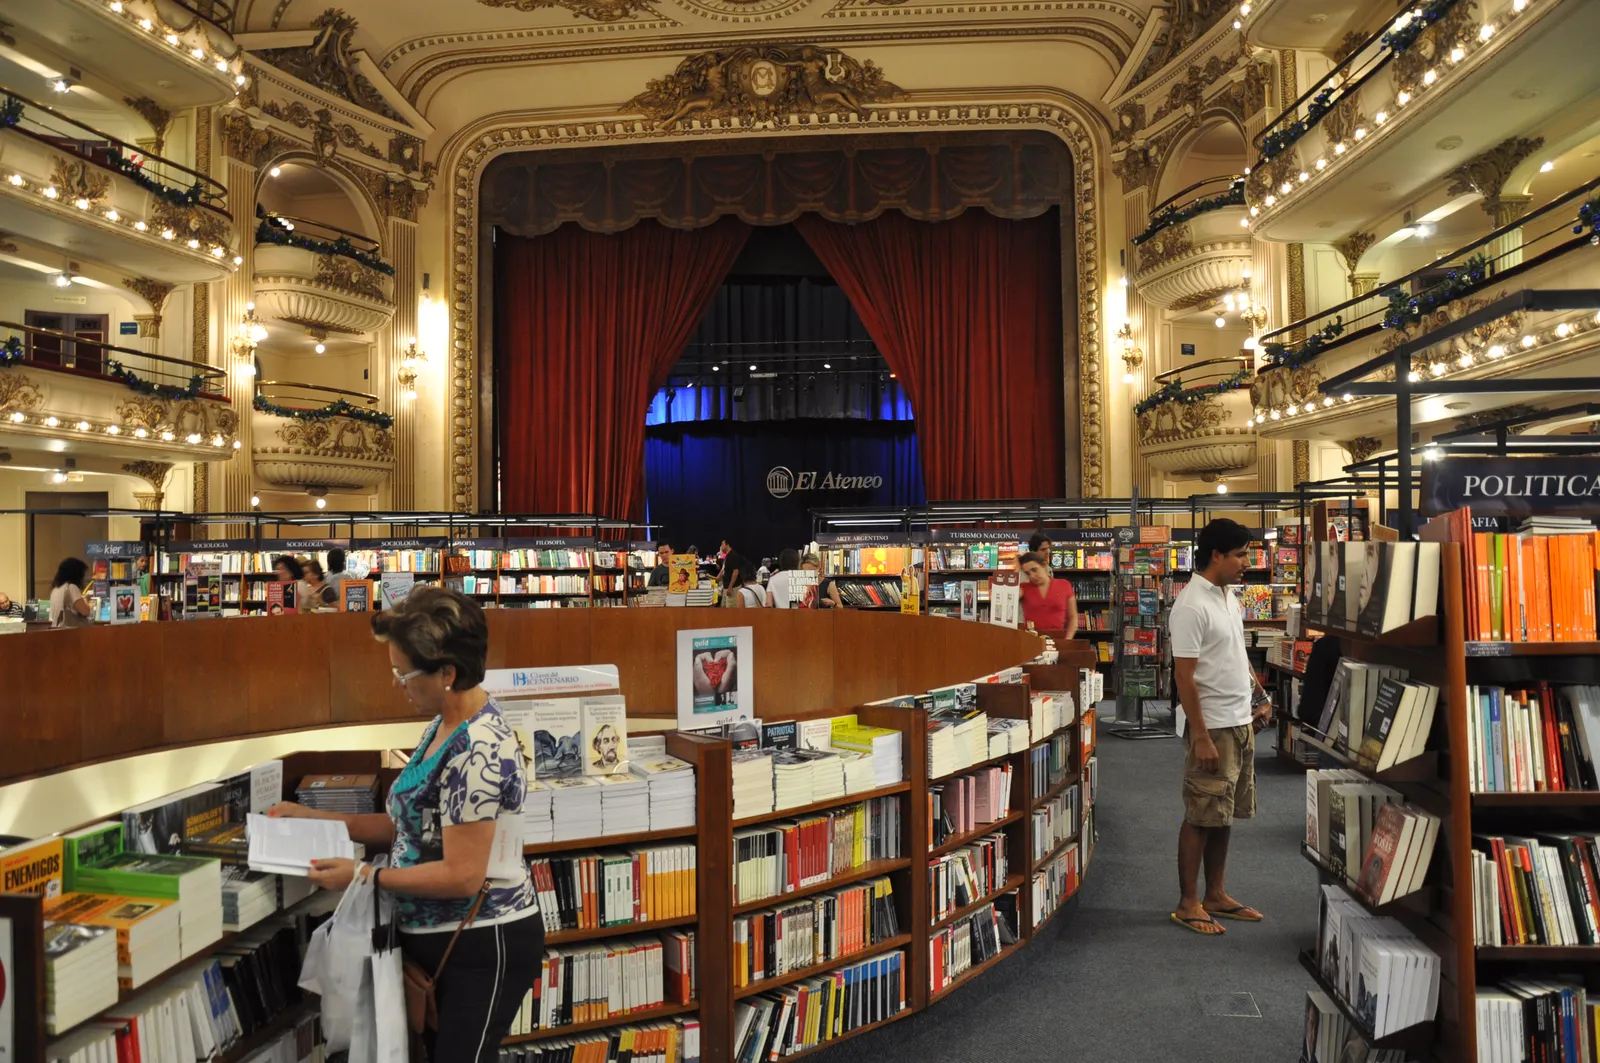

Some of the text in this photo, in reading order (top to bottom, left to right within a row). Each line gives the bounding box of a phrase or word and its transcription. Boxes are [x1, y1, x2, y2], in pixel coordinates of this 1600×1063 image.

[794, 470, 882, 490] El Ateneo
[1463, 475, 1600, 497] POLITICA
[104, 544, 122, 555] kier
[694, 639, 709, 648] quid
[767, 724, 795, 738] PATRIOTAS
[5, 853, 60, 891] ENEMIGOS
